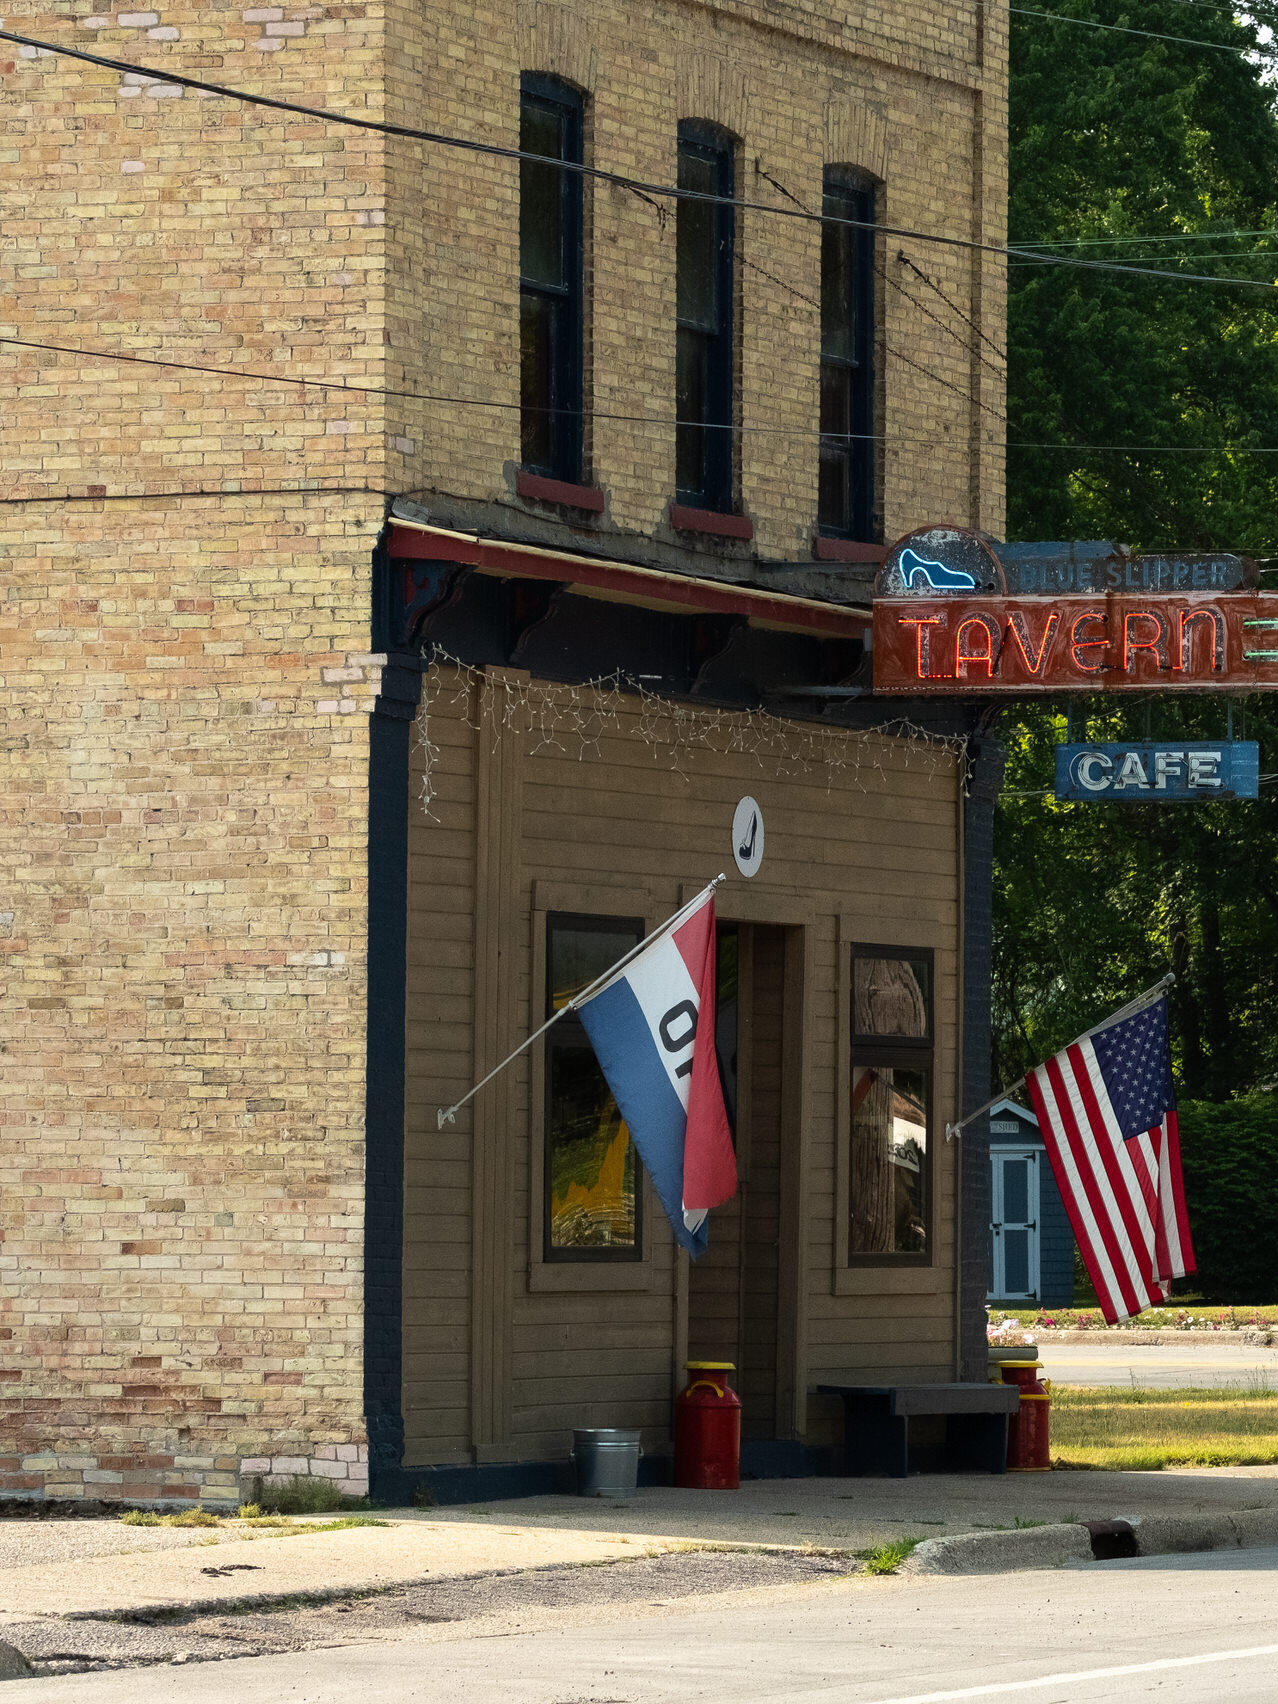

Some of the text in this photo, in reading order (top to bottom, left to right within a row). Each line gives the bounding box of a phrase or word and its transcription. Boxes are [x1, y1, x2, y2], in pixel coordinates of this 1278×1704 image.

[1018, 560, 1227, 590] BLUE SLIPPER
[897, 610, 1227, 679] TAVERN
[1076, 751, 1222, 791] CAFE
